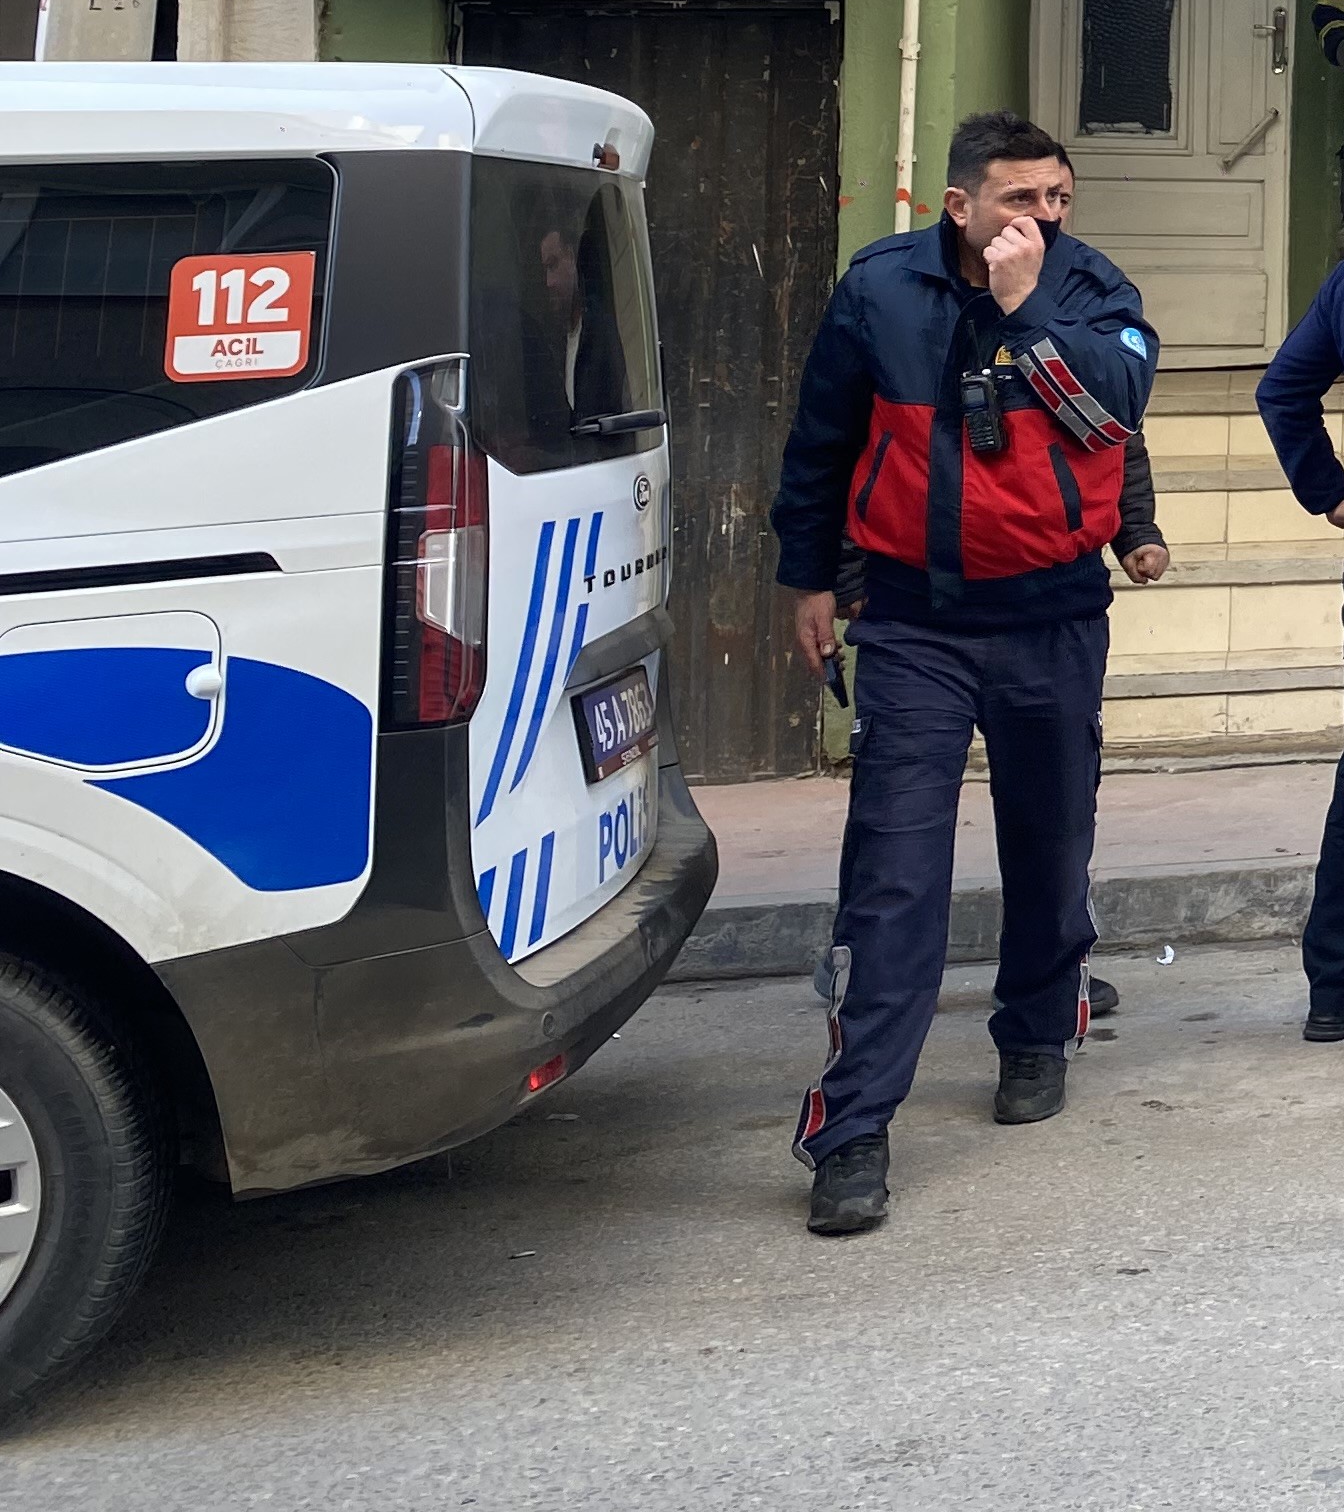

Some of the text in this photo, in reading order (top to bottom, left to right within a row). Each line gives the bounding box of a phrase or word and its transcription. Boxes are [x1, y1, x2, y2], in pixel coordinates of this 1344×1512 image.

[192, 267, 290, 326] 112
[595, 701, 614, 753] 45
[611, 695, 627, 745] A
